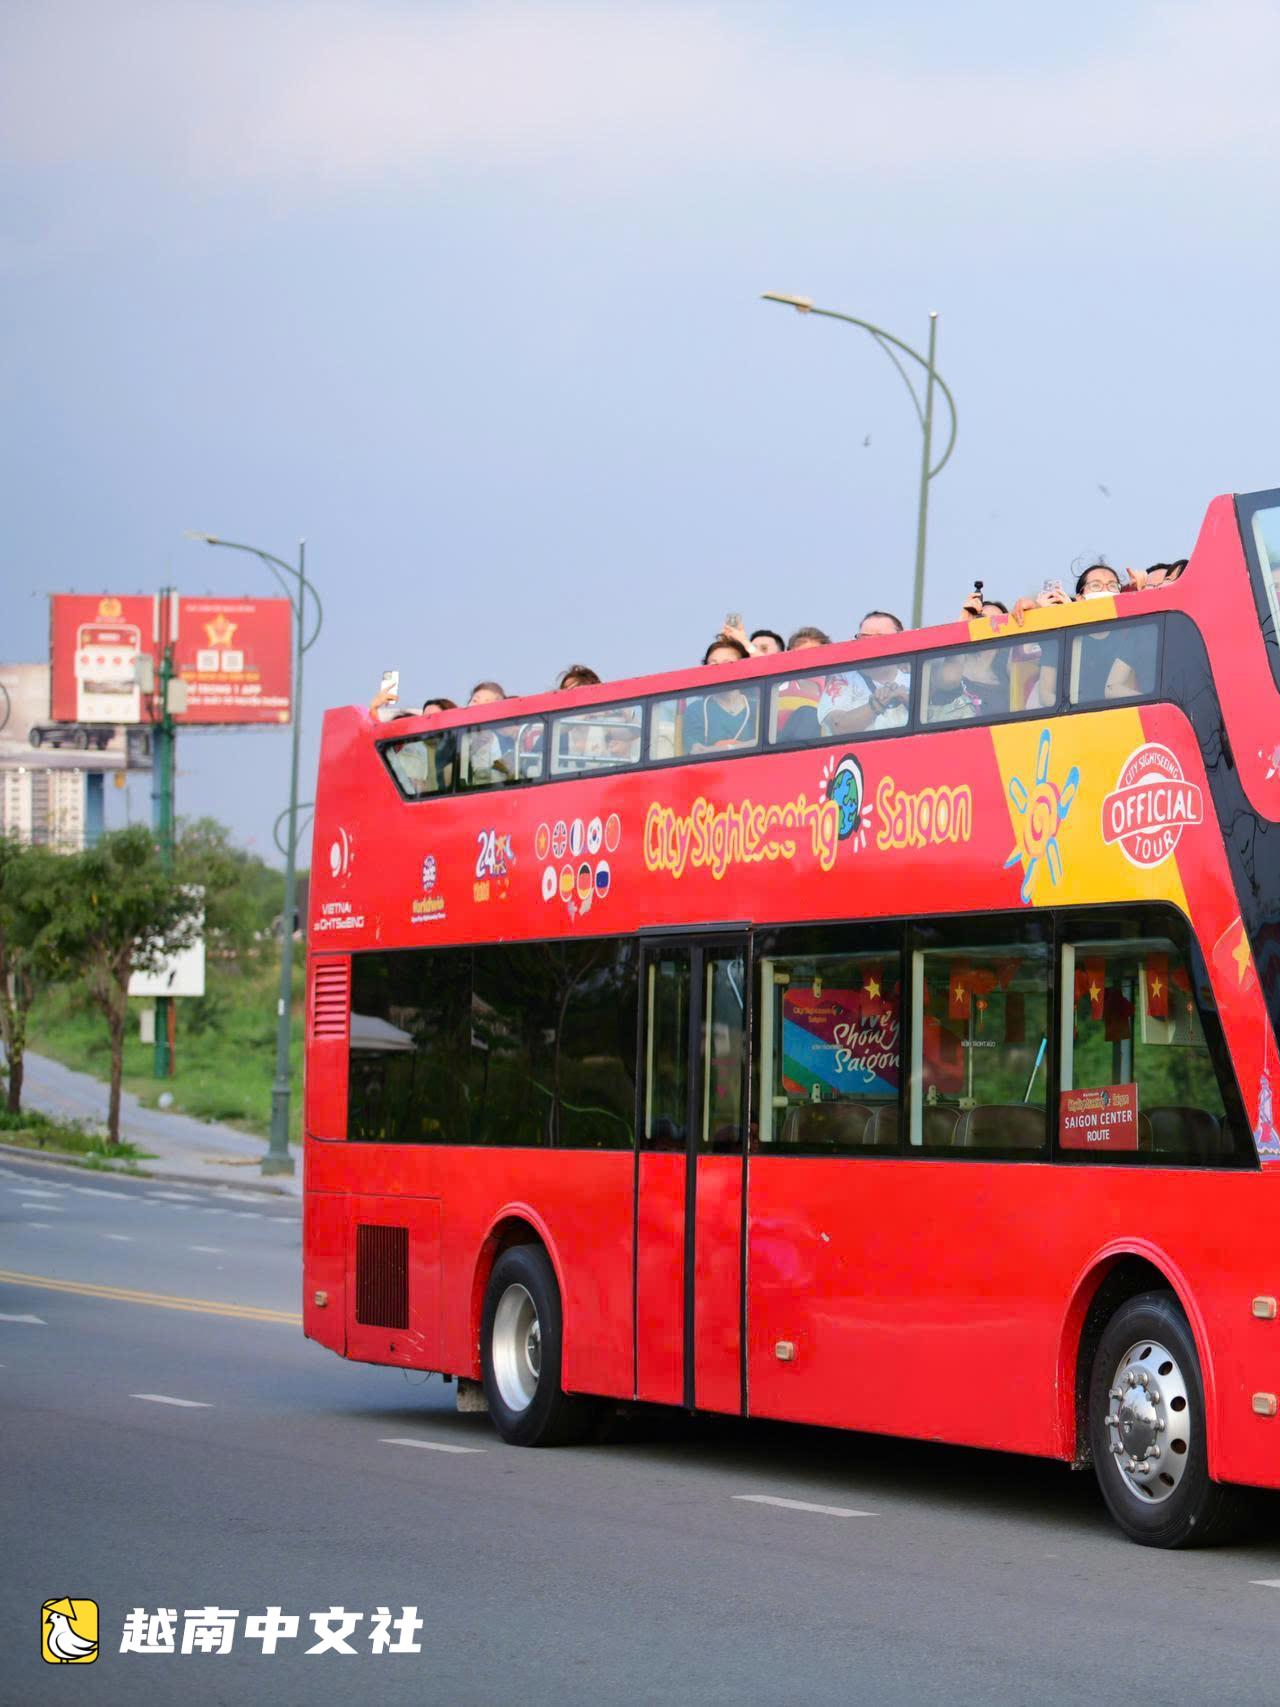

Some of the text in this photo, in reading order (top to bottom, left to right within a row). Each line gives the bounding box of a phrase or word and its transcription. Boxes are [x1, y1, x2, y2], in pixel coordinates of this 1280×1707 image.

[1125, 752, 1180, 785] CITY SIGHTSEEING
[1111, 788, 1197, 834] OFFICIAL
[1134, 829, 1174, 860] TOUR
[834, 1048, 900, 1084] Saigon
[1064, 1109, 1133, 1129] SAIGON CENTER
[1087, 1129, 1110, 1142] ROUTE
